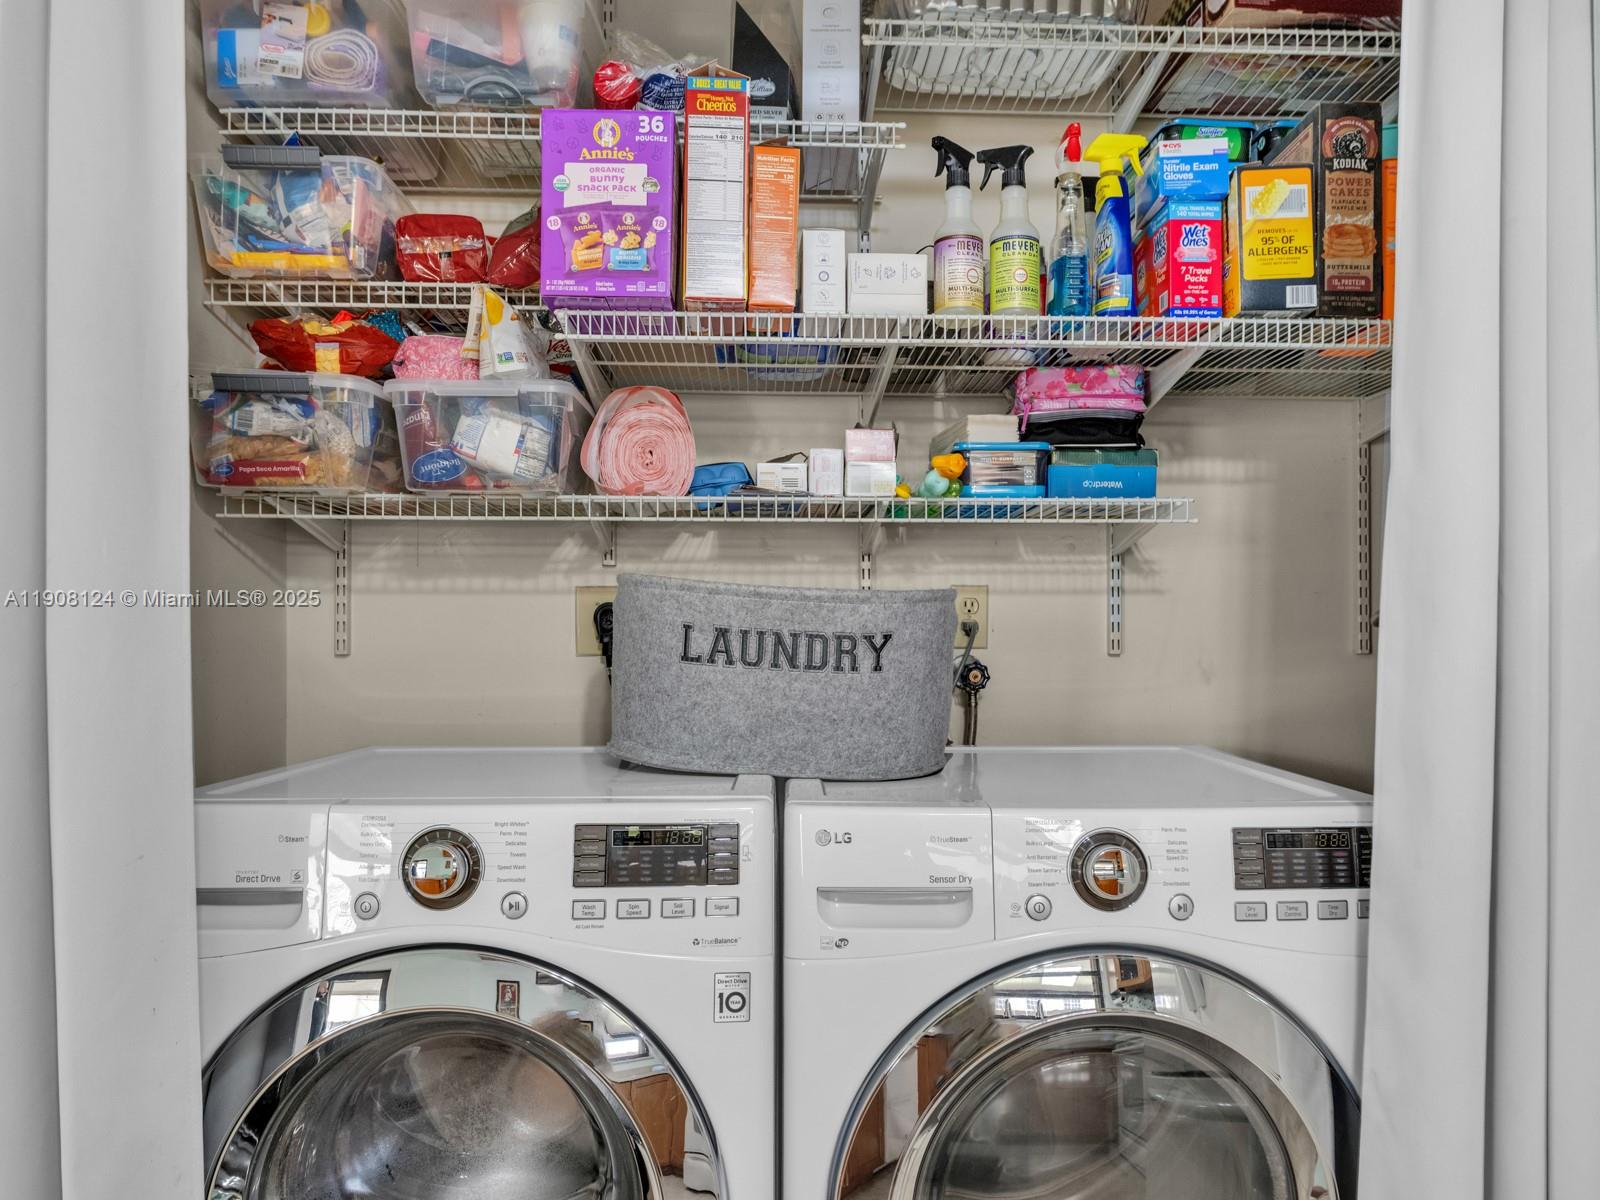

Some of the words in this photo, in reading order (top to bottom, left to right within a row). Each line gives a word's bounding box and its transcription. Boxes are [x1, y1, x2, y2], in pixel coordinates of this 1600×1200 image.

[696, 98, 736, 112] Cheerios
[638, 115, 664, 134] 36
[1199, 127, 1226, 136] Swiffer
[579, 146, 634, 160] Annie's
[1193, 162, 1218, 170] Exam
[1333, 158, 1368, 170] KODIAK
[1164, 172, 1194, 180] Gloves
[1328, 178, 1372, 186] POWER
[1330, 188, 1370, 197] CAKES
[549, 219, 559, 227] 18
[1184, 225, 1209, 238] Wet
[1182, 237, 1208, 247] Ones
[1281, 235, 1295, 244] OF
[1002, 241, 1038, 253] MEYER'S
[1248, 246, 1308, 256] ALLERGENS
[1188, 266, 1212, 274] Travel
[1084, 480, 1123, 488] Waterdrop
[680, 621, 894, 673] LAUNDRY
[834, 832, 852, 844] LG
[236, 875, 259, 883] Direct
[929, 875, 956, 883] Sensor
[959, 875, 972, 884] Dry
[719, 992, 746, 1013] 10
